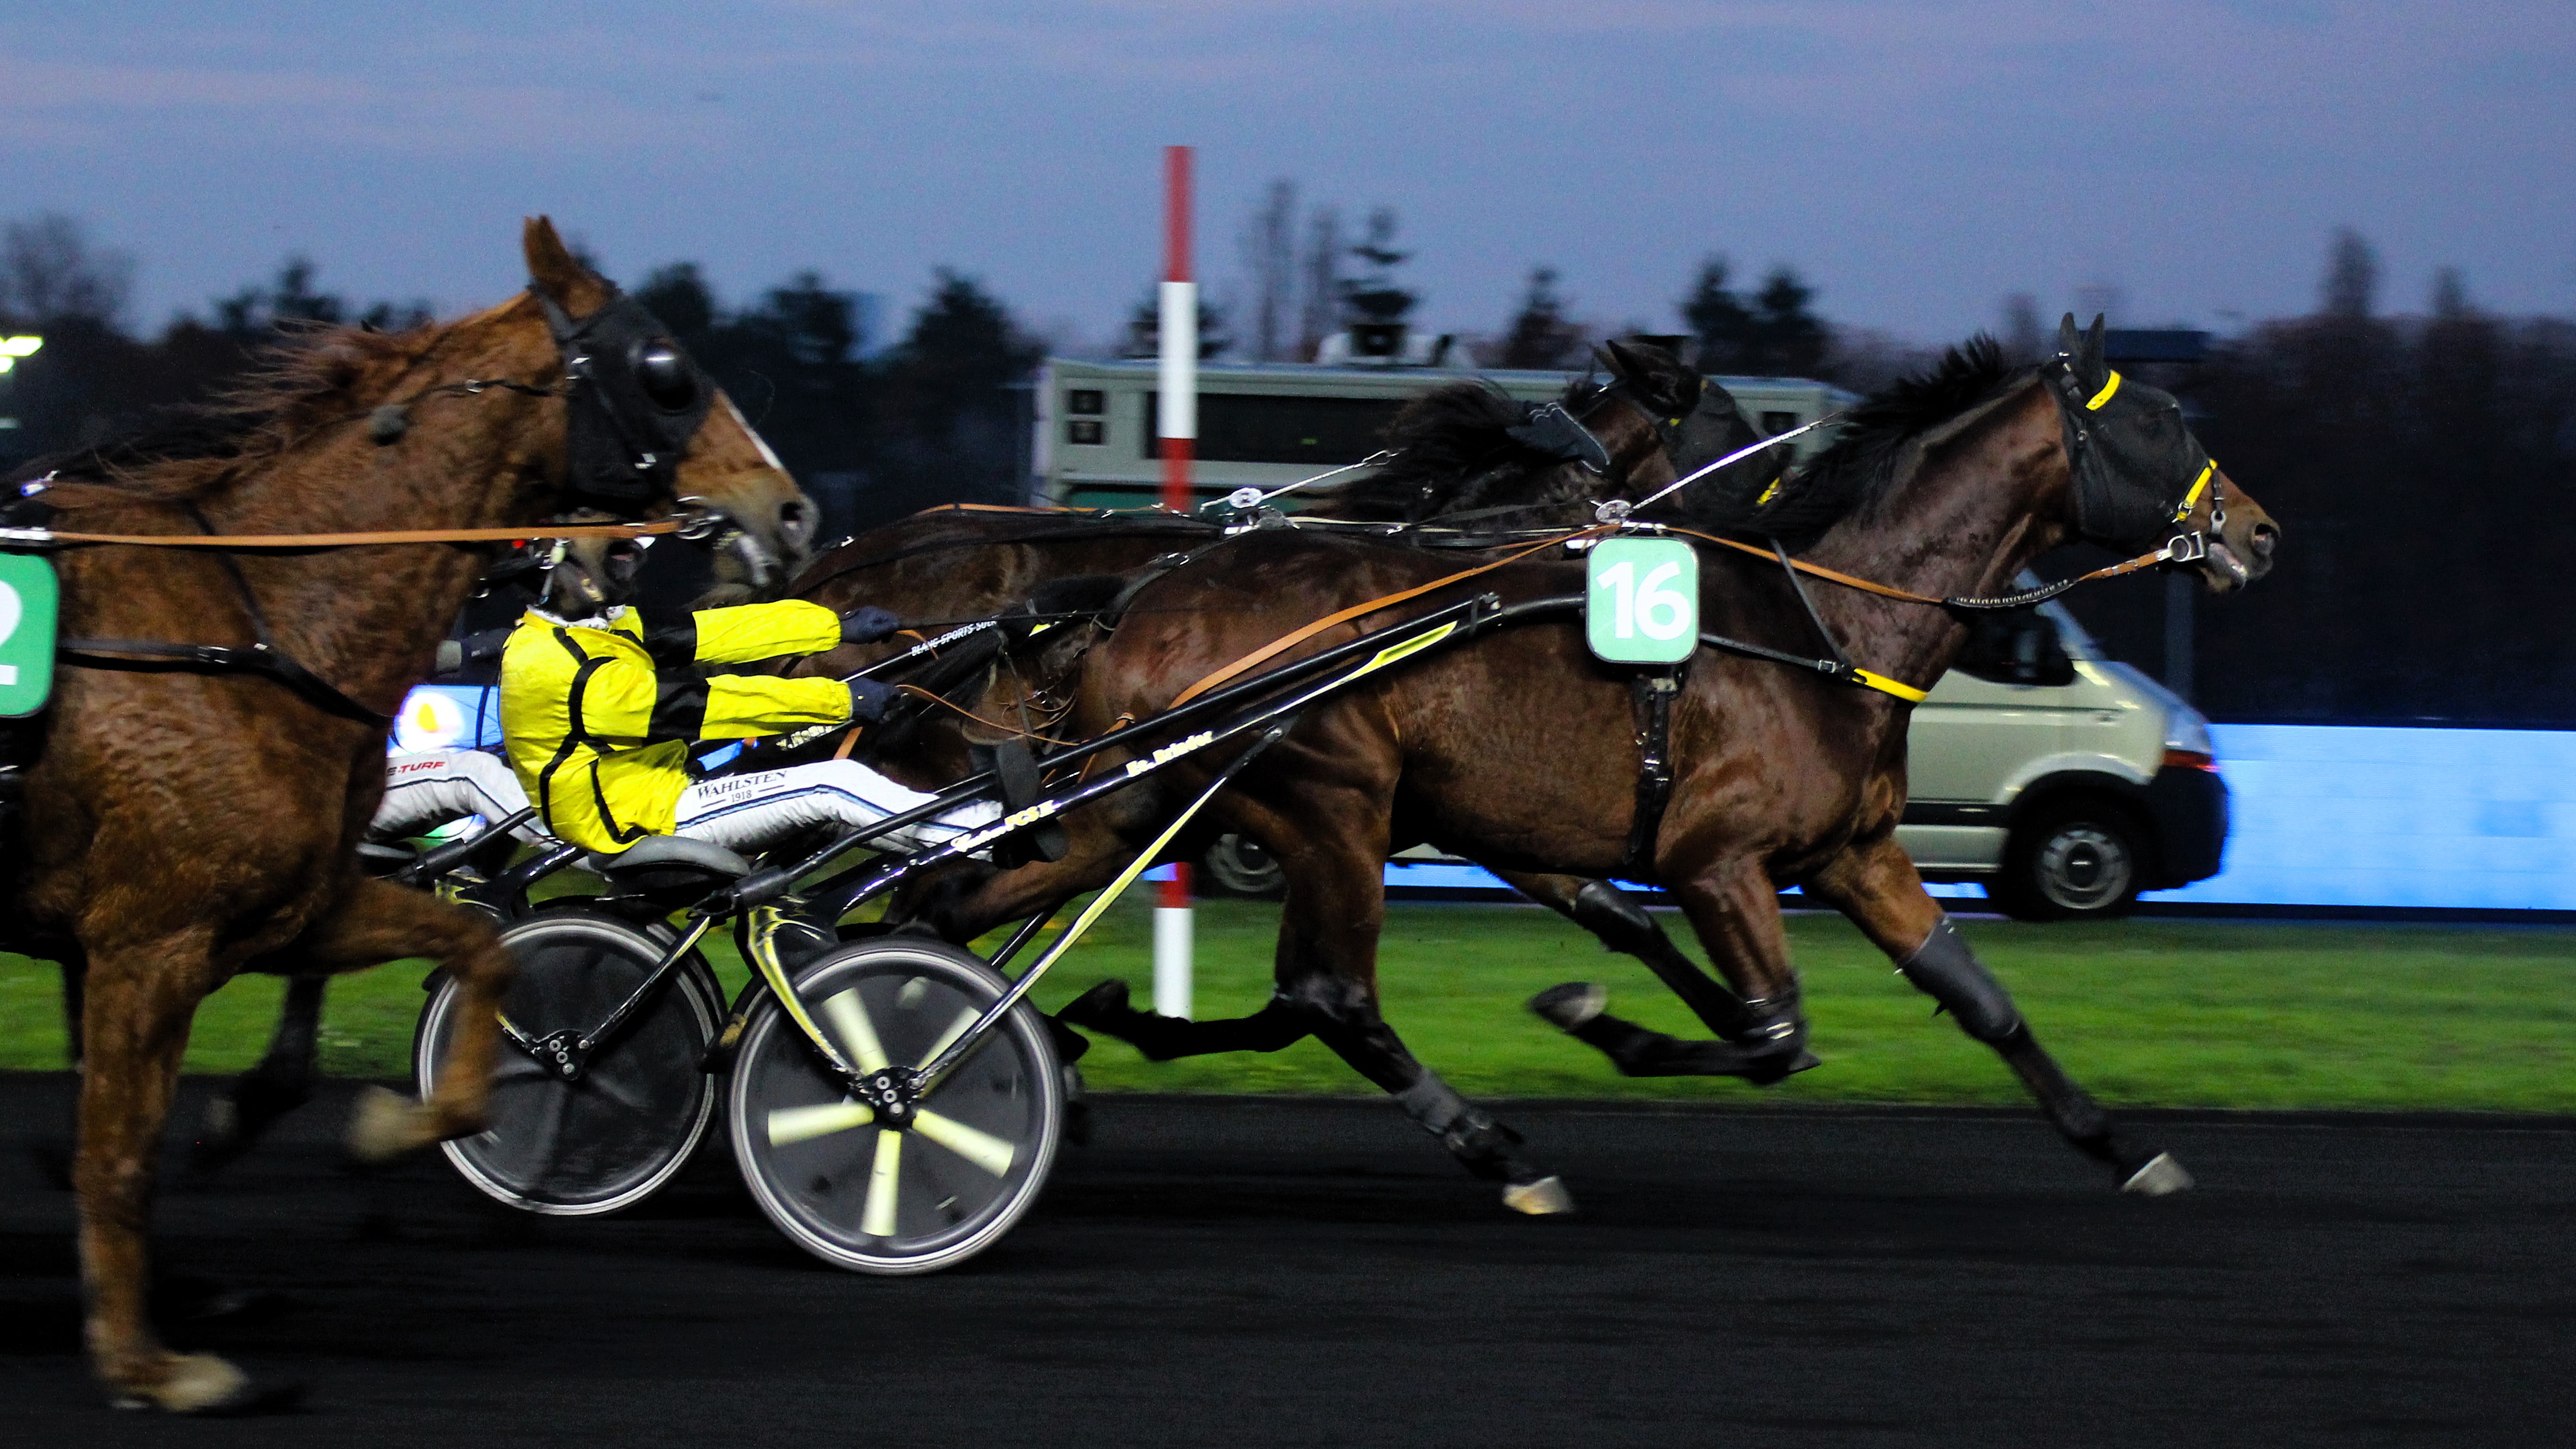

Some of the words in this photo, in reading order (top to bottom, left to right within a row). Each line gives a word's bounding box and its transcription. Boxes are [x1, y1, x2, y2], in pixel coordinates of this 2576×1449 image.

[1595, 561, 1692, 641] 16
[941, 624, 974, 644] SPORTS
[731, 789, 752, 802] 1918
